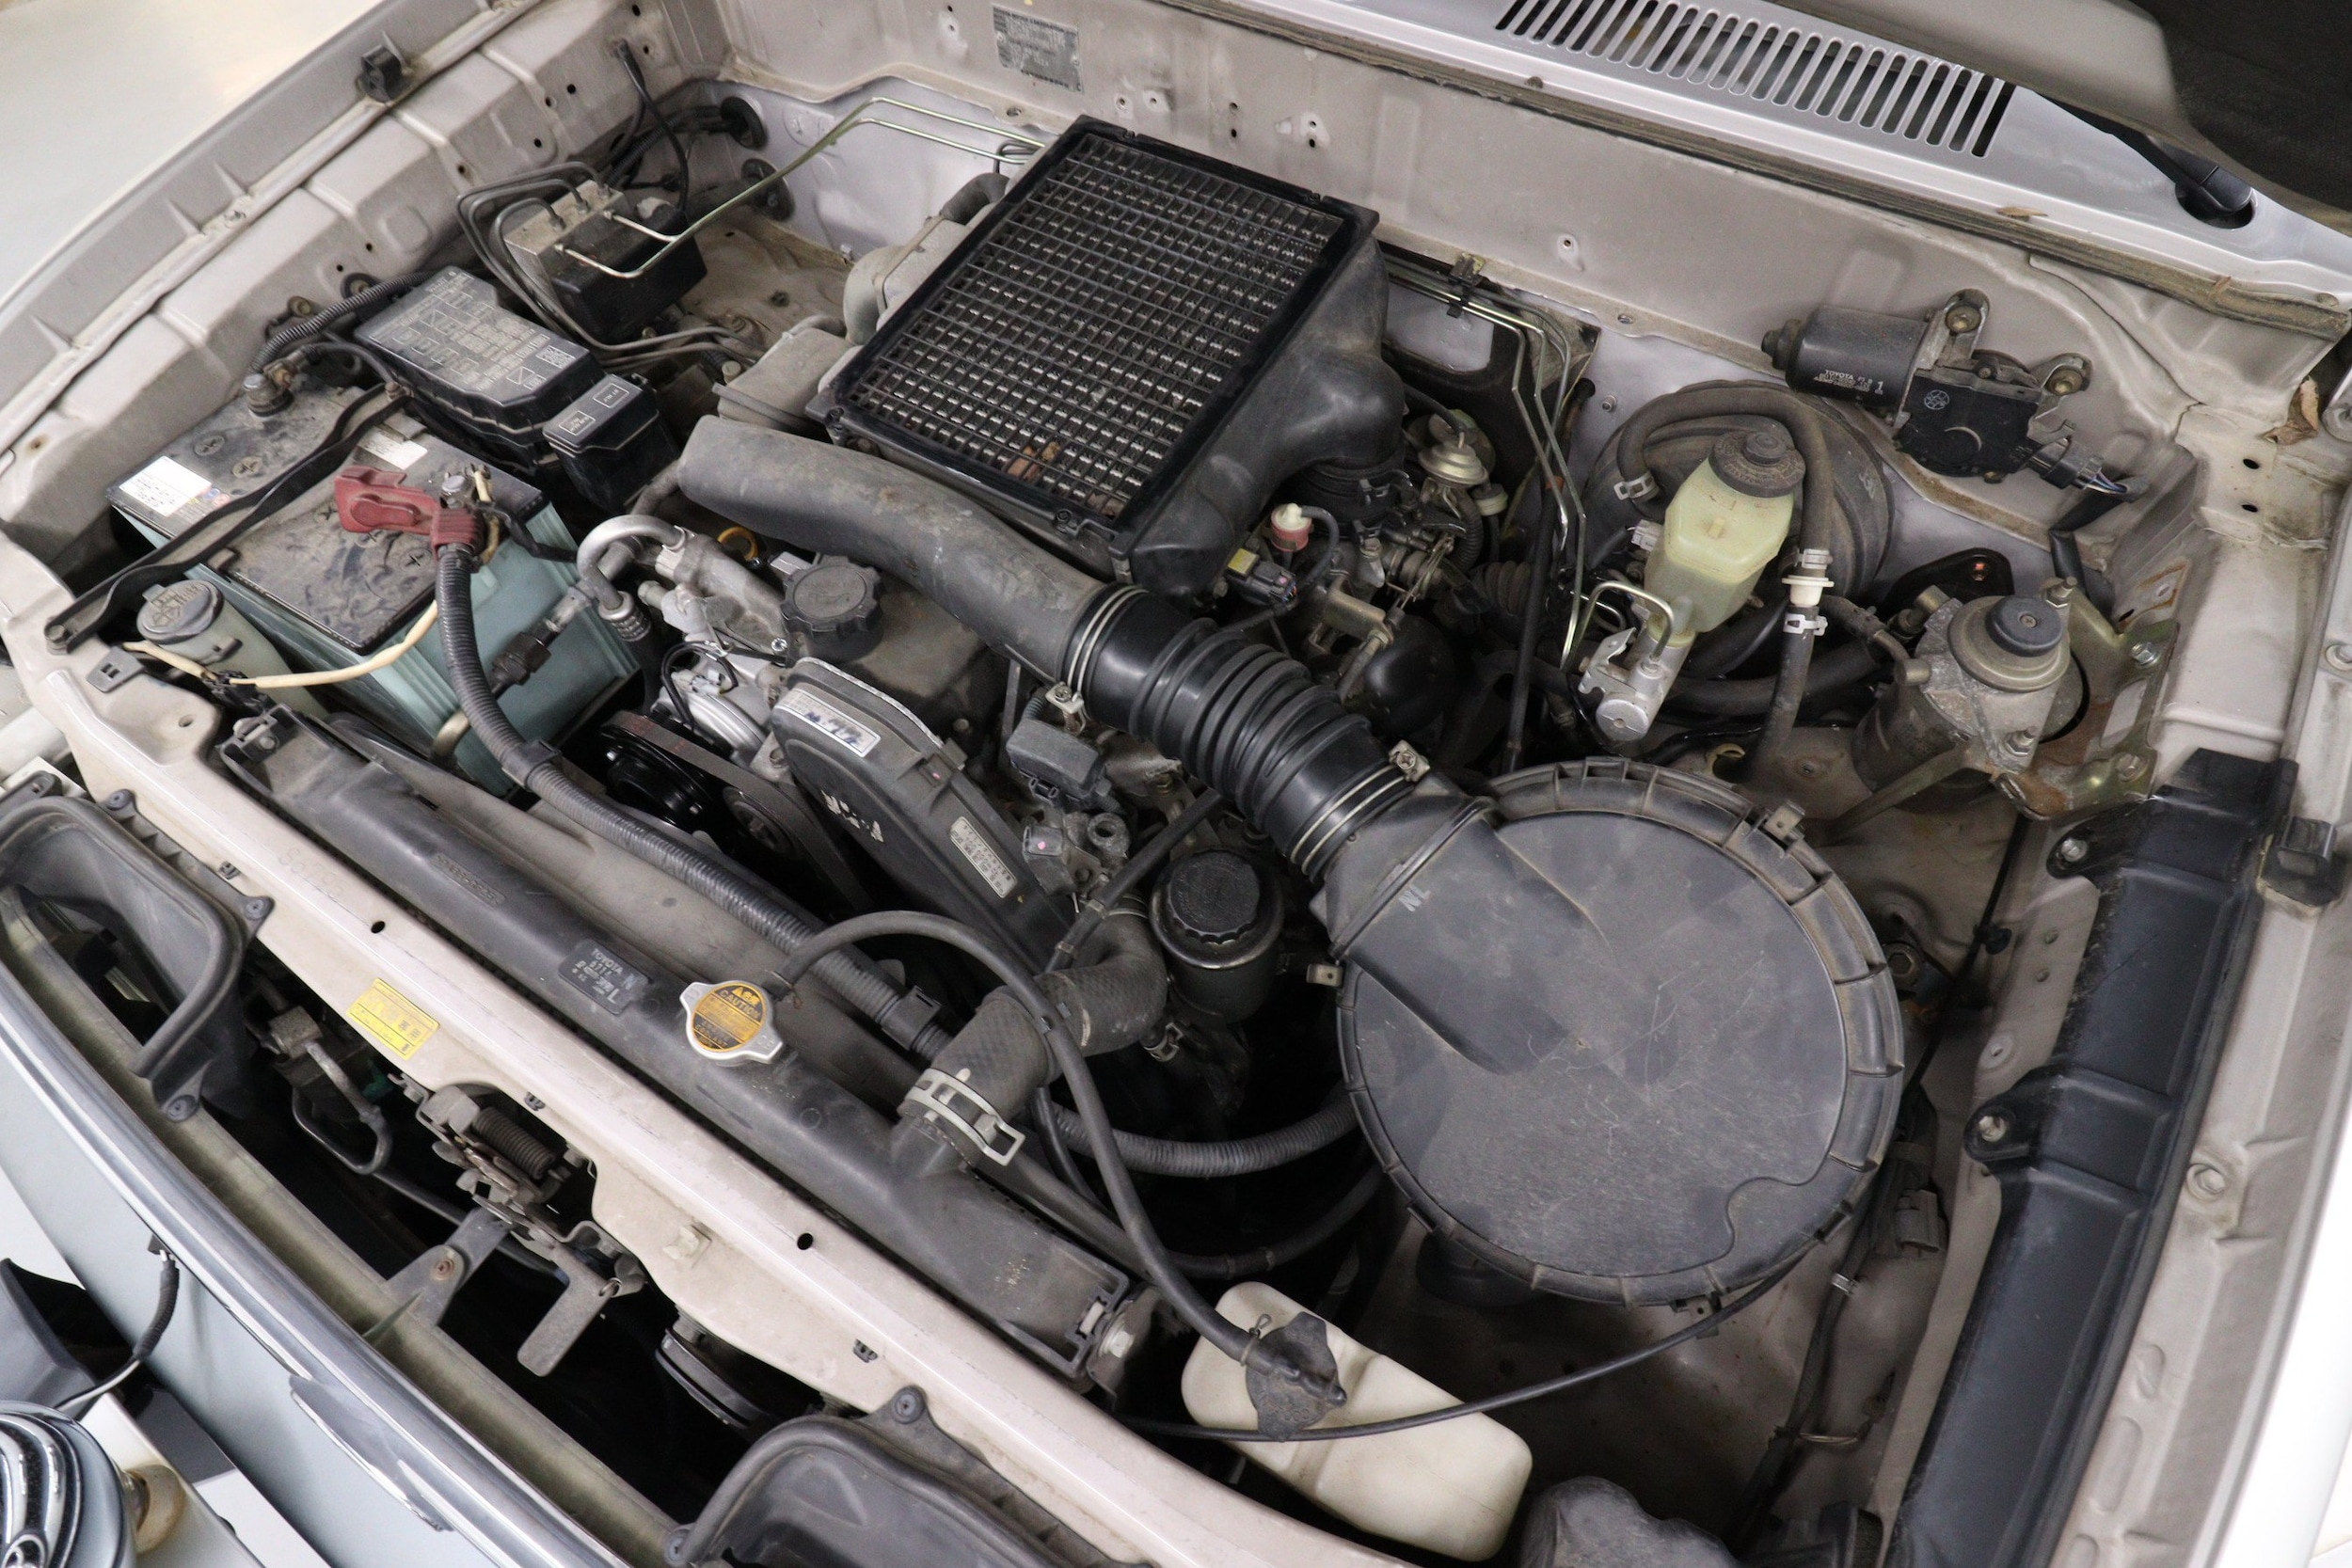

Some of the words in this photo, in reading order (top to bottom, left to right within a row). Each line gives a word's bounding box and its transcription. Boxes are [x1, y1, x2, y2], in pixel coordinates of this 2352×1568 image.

[1825, 369, 1853, 380] TOYOTA
[591, 947, 623, 975] TOYOTA
[719, 989, 762, 1020] CAUTION
